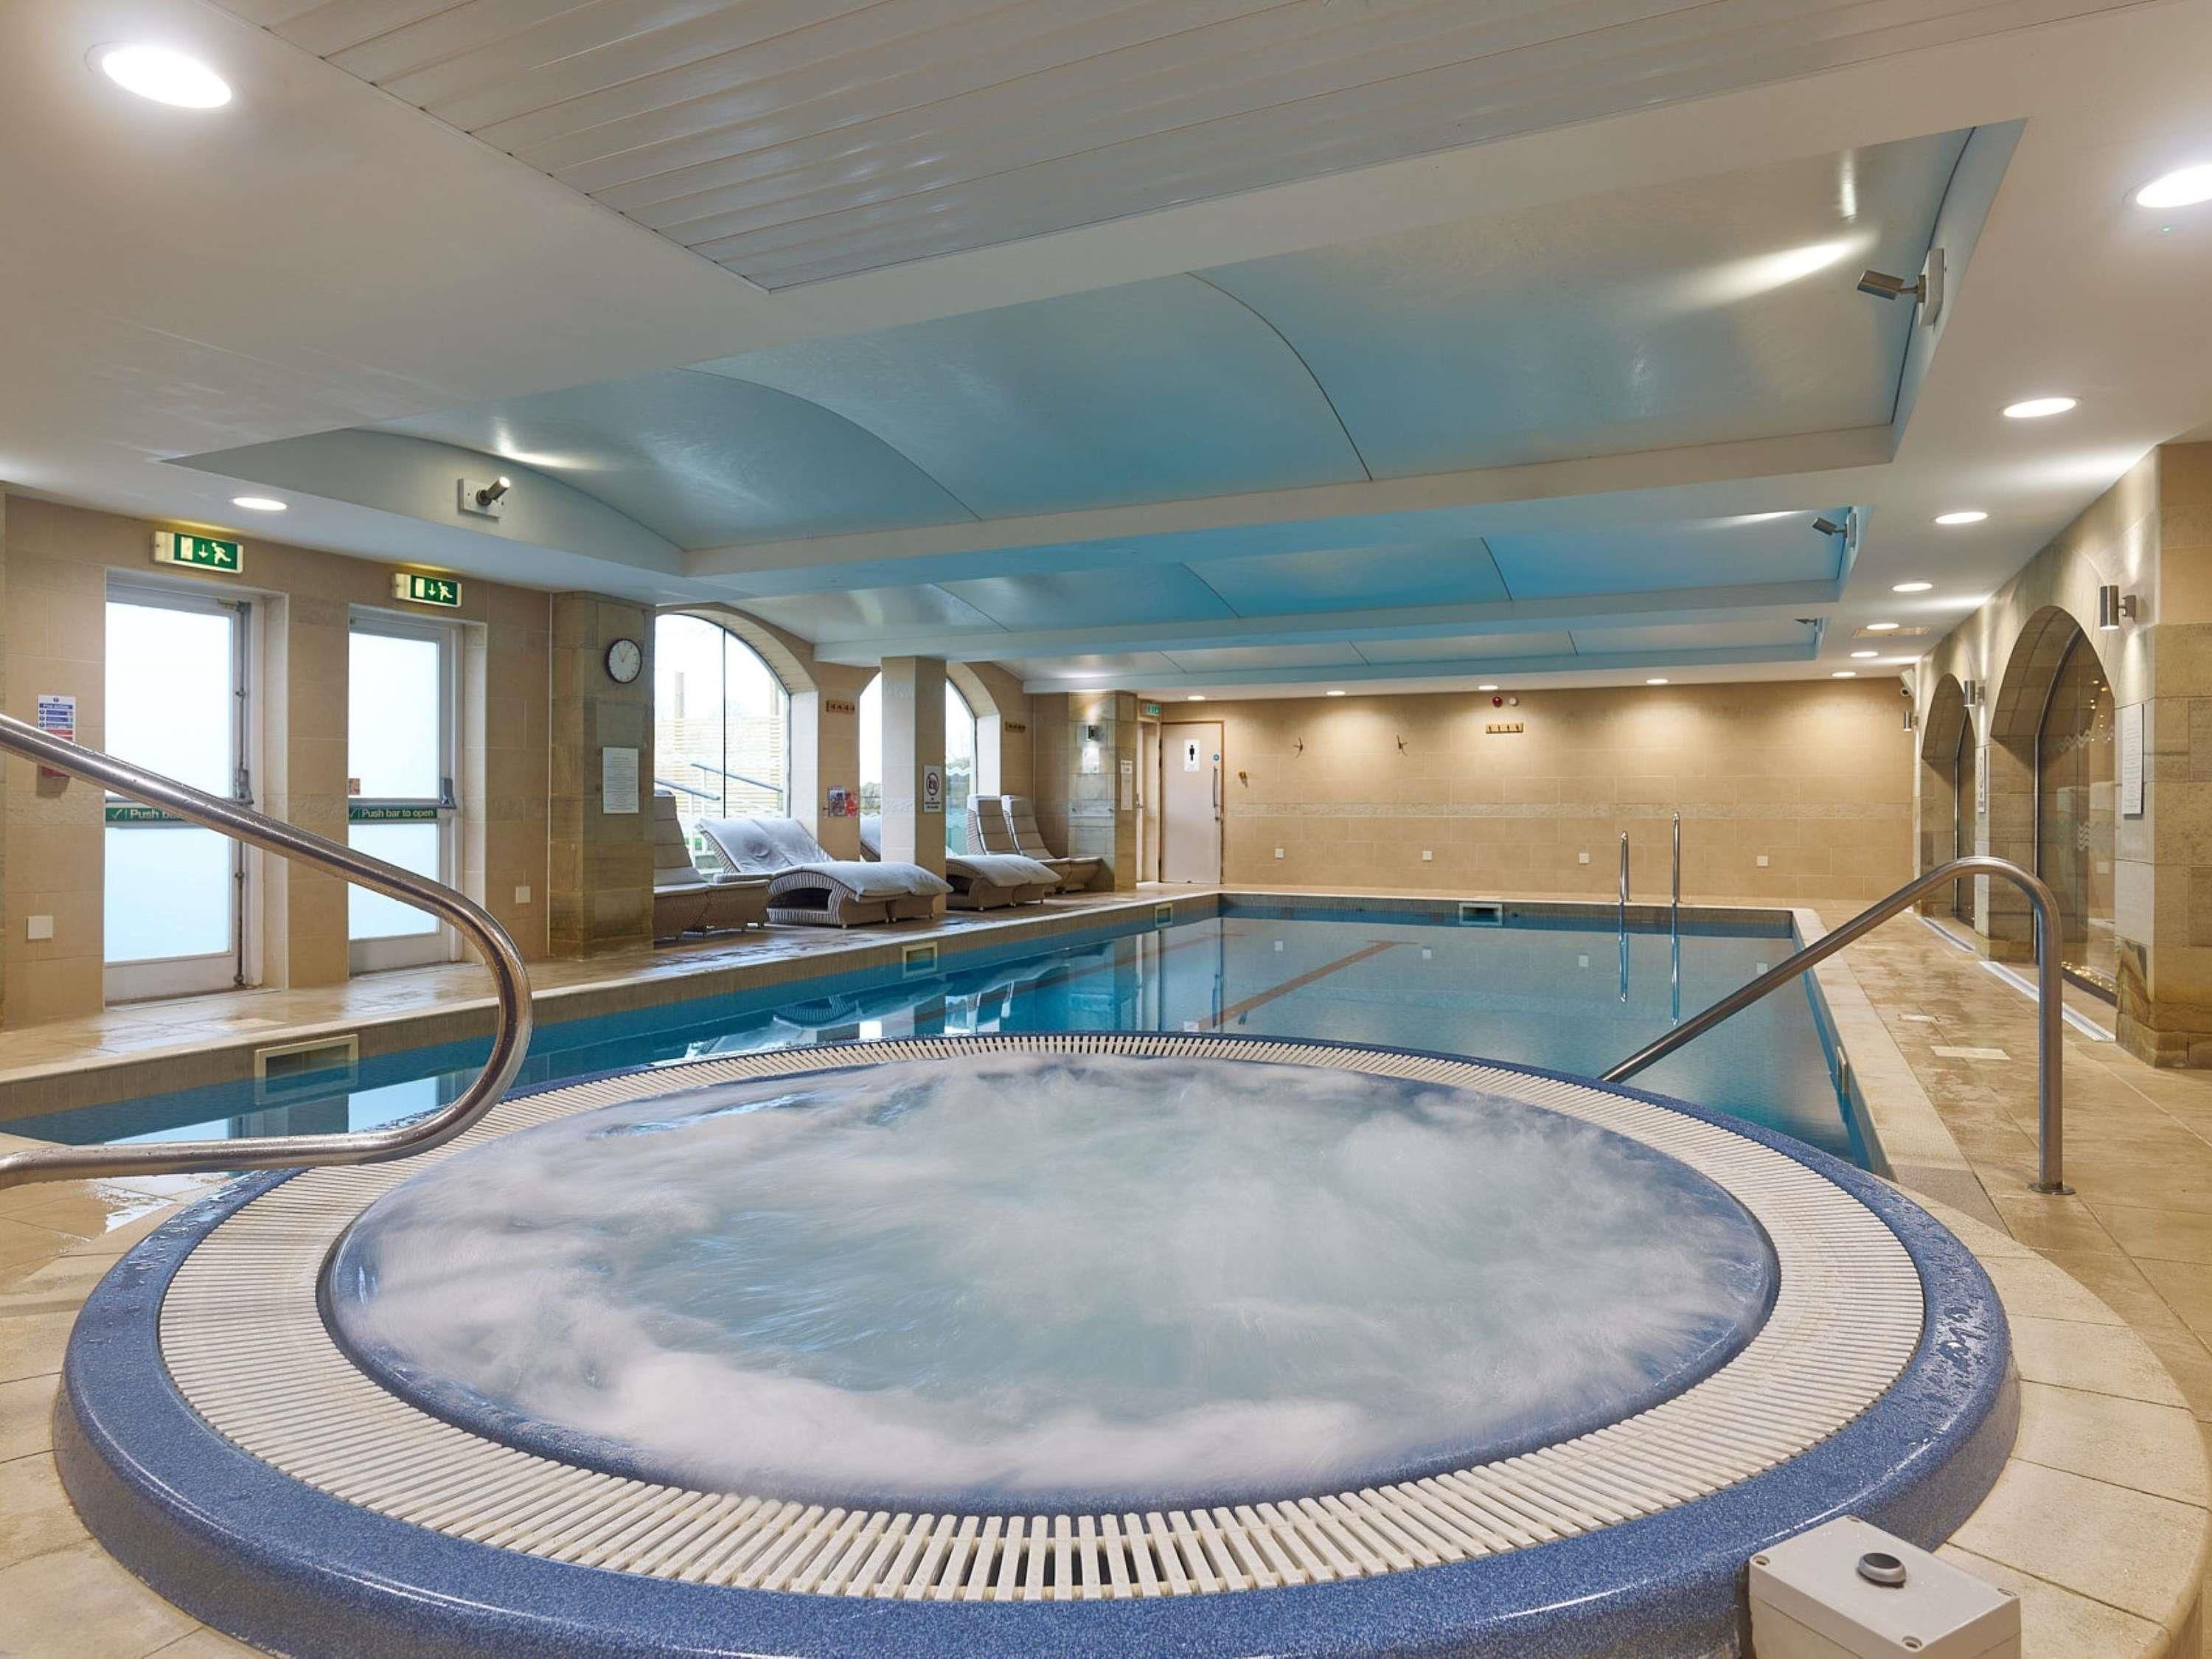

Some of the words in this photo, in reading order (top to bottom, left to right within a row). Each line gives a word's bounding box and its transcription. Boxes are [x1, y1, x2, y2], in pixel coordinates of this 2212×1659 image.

[130, 809, 159, 819] Push
[361, 808, 383, 818] Push
[386, 808, 400, 817] bar
[402, 809, 411, 817] to
[413, 810, 434, 818] open
